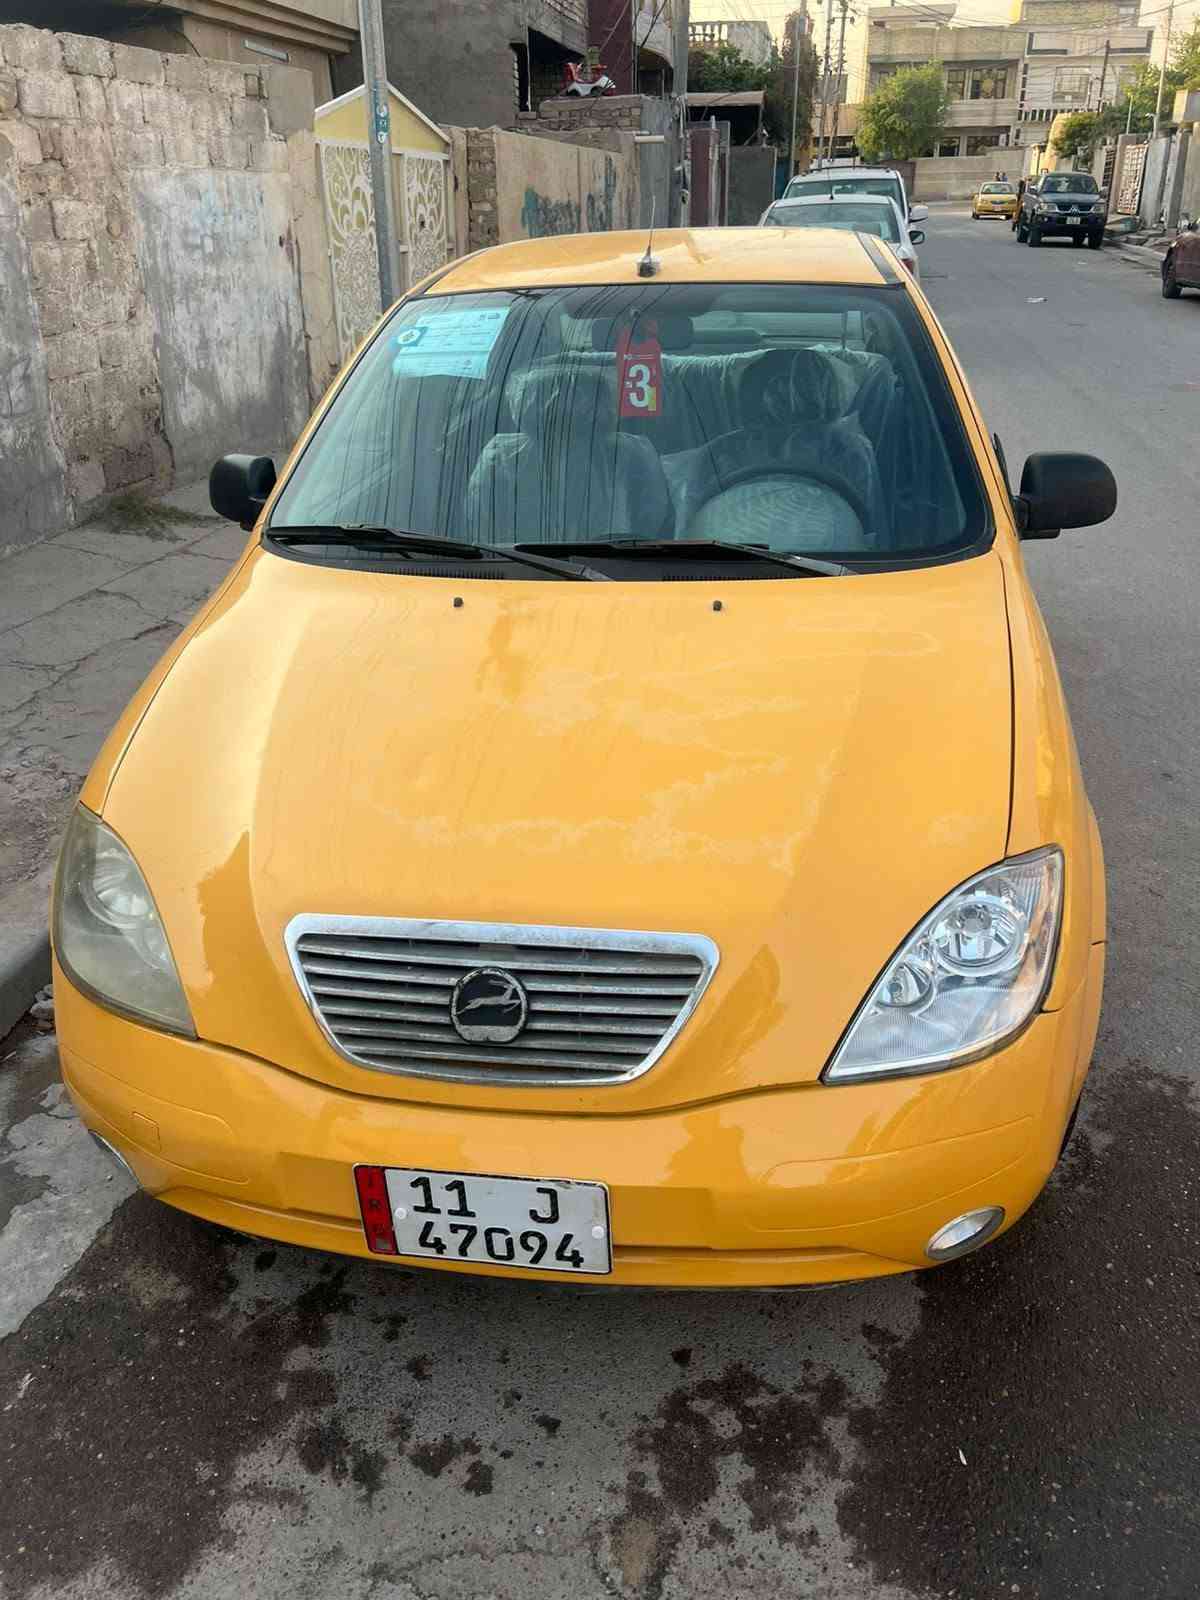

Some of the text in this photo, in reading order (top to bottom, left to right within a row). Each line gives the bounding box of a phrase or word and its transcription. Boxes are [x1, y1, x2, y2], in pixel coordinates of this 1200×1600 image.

[628, 363, 651, 408] 3
[409, 1176, 476, 1218] 11
[529, 1187, 560, 1225] J
[418, 1221, 585, 1269] 47094
